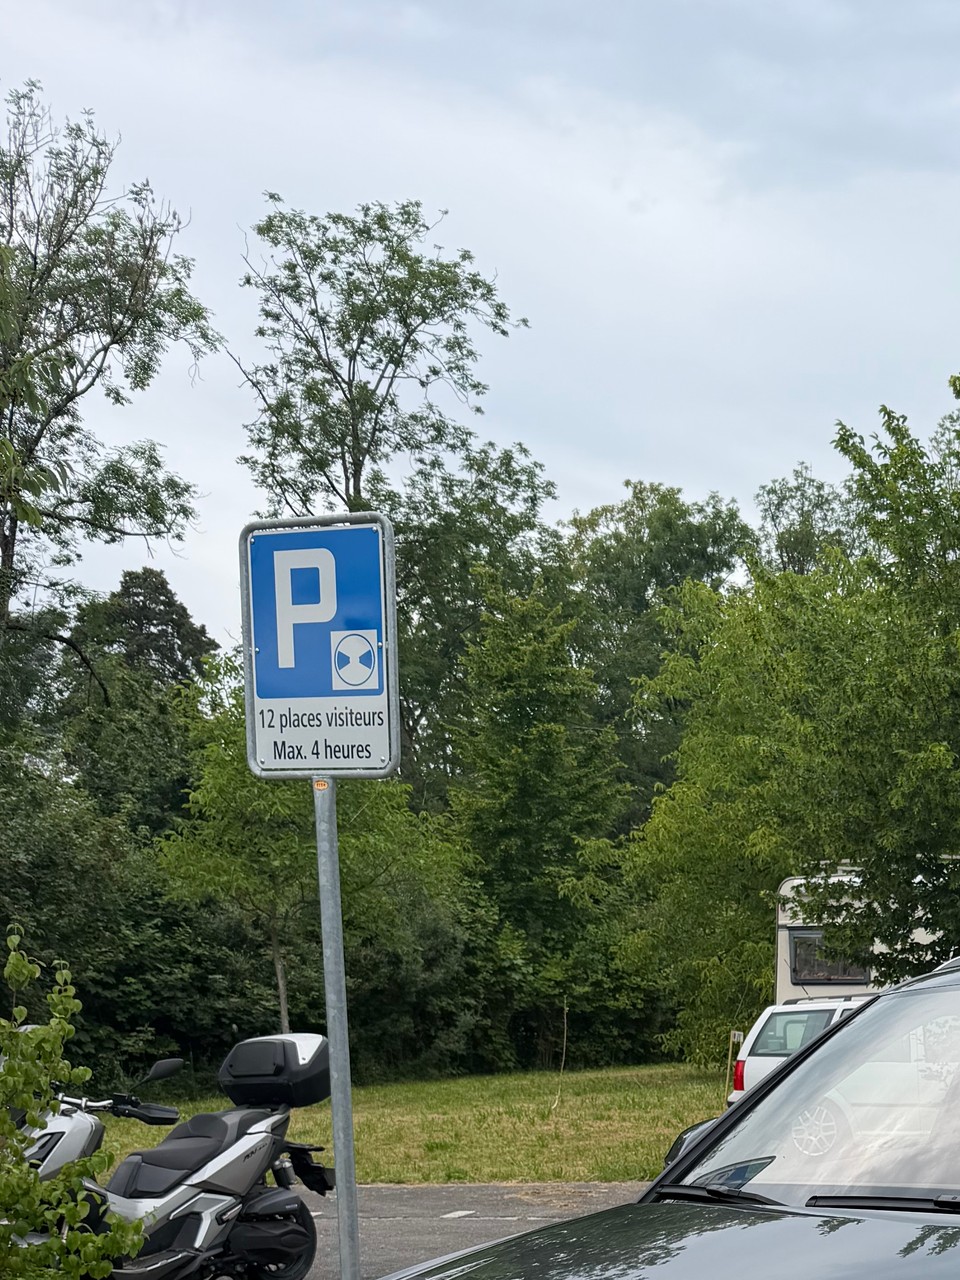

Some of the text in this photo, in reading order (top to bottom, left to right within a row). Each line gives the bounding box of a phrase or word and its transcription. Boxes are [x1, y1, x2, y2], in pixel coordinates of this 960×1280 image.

[273, 547, 337, 669] P
[259, 706, 384, 733] 12 places visiteurs
[273, 738, 371, 760] Max. 4 heures
